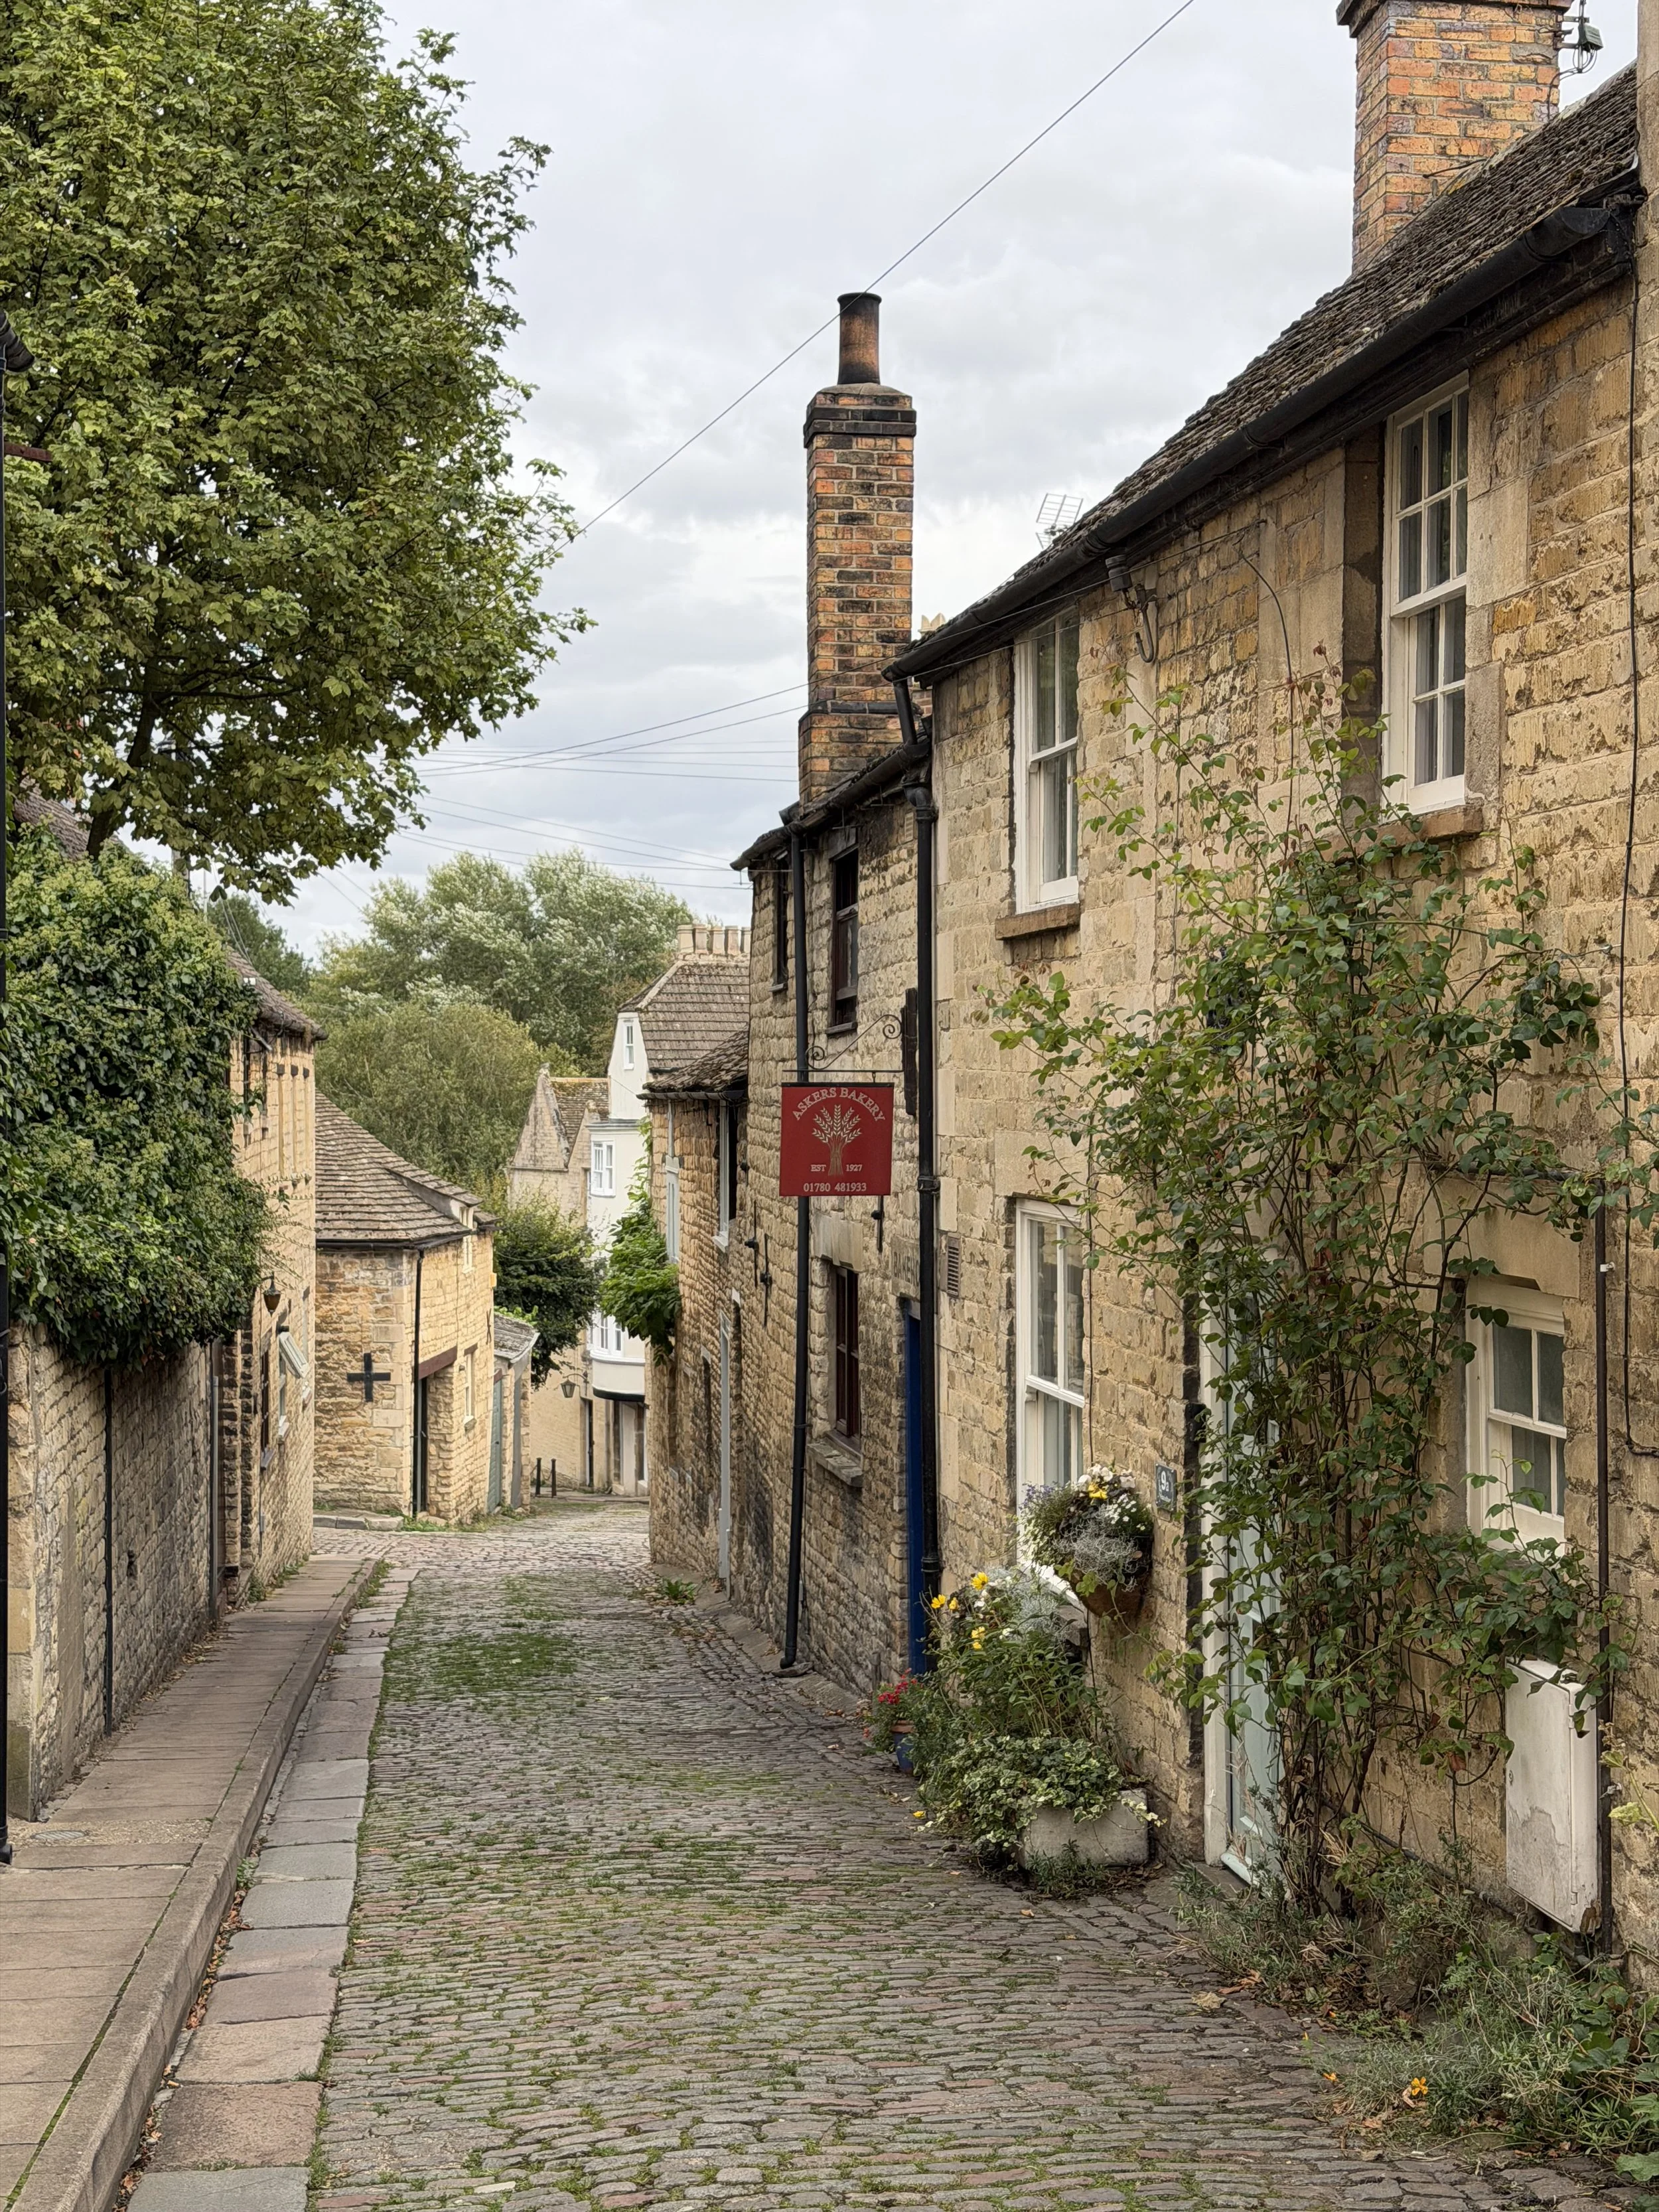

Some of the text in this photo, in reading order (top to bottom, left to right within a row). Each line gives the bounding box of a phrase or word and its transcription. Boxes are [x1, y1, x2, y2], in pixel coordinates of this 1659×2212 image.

[792, 1087, 886, 1122] ASKERS BAKERY
[803, 1183, 867, 1192] 01780 481933
[1161, 1470, 1169, 1492] 9a
